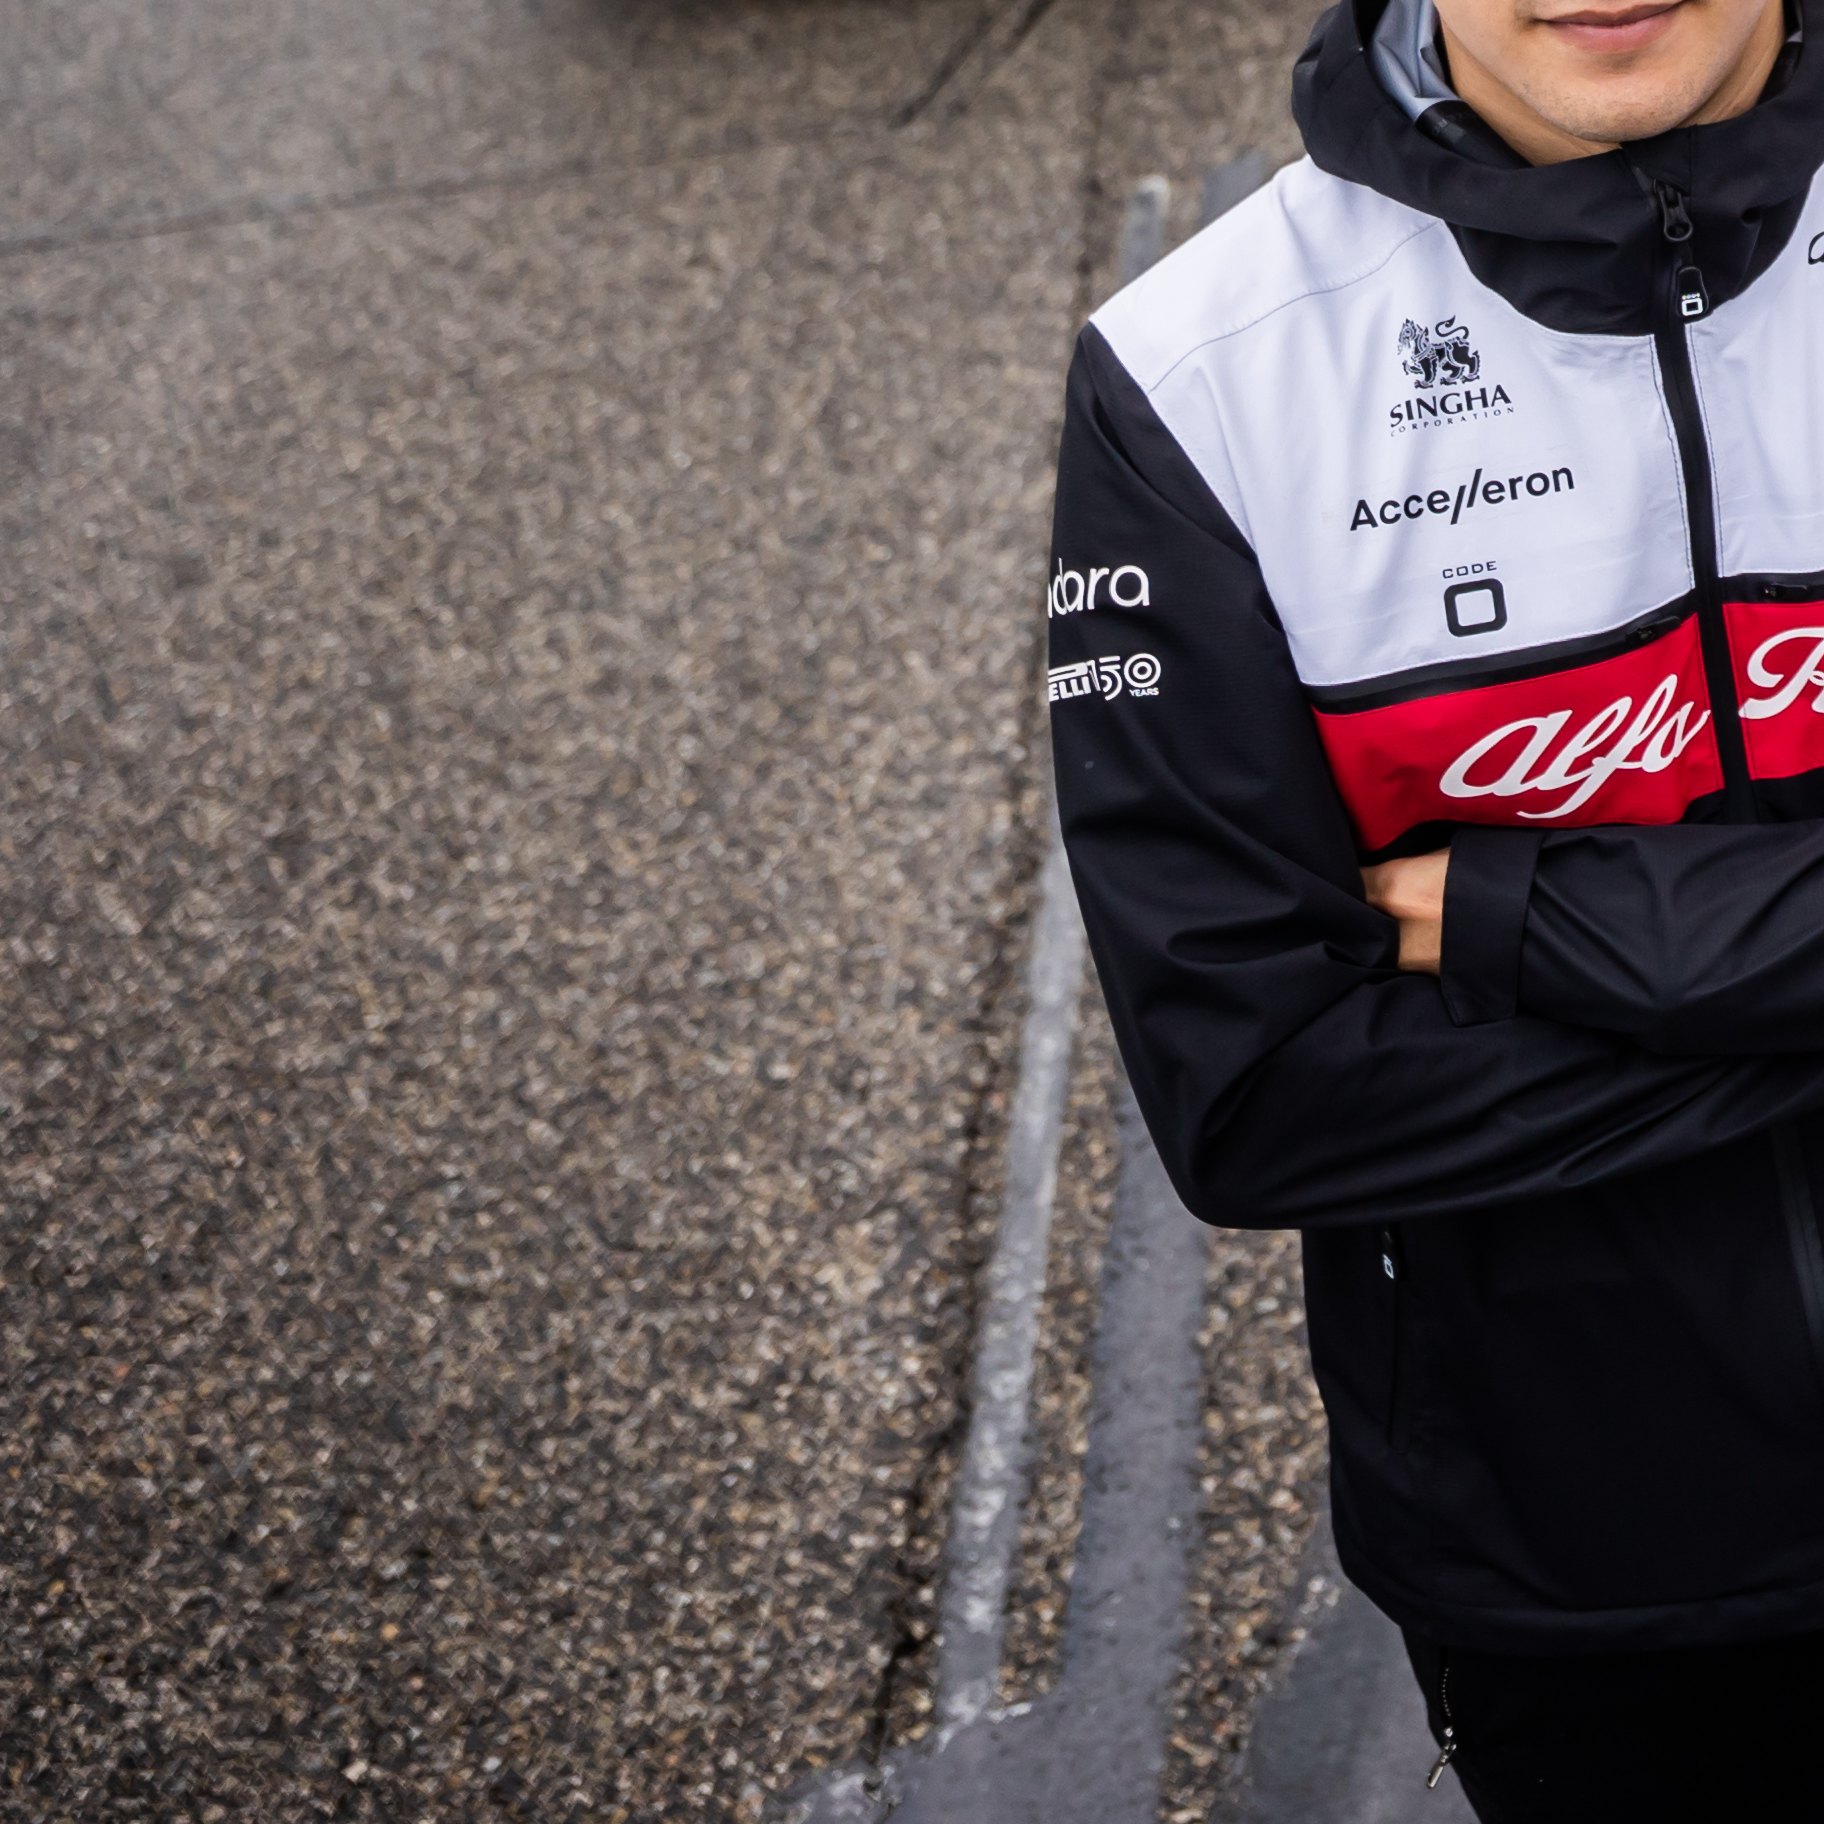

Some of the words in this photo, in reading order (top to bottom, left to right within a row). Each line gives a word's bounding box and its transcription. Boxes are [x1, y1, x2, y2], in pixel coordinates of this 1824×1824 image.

[1389, 383, 1513, 428] SINGHA
[1389, 406, 1515, 437] CORPORATION
[1441, 560, 1499, 580] CODE
[1128, 687, 1160, 697] YEARS
[1439, 673, 1711, 820] Alfa
